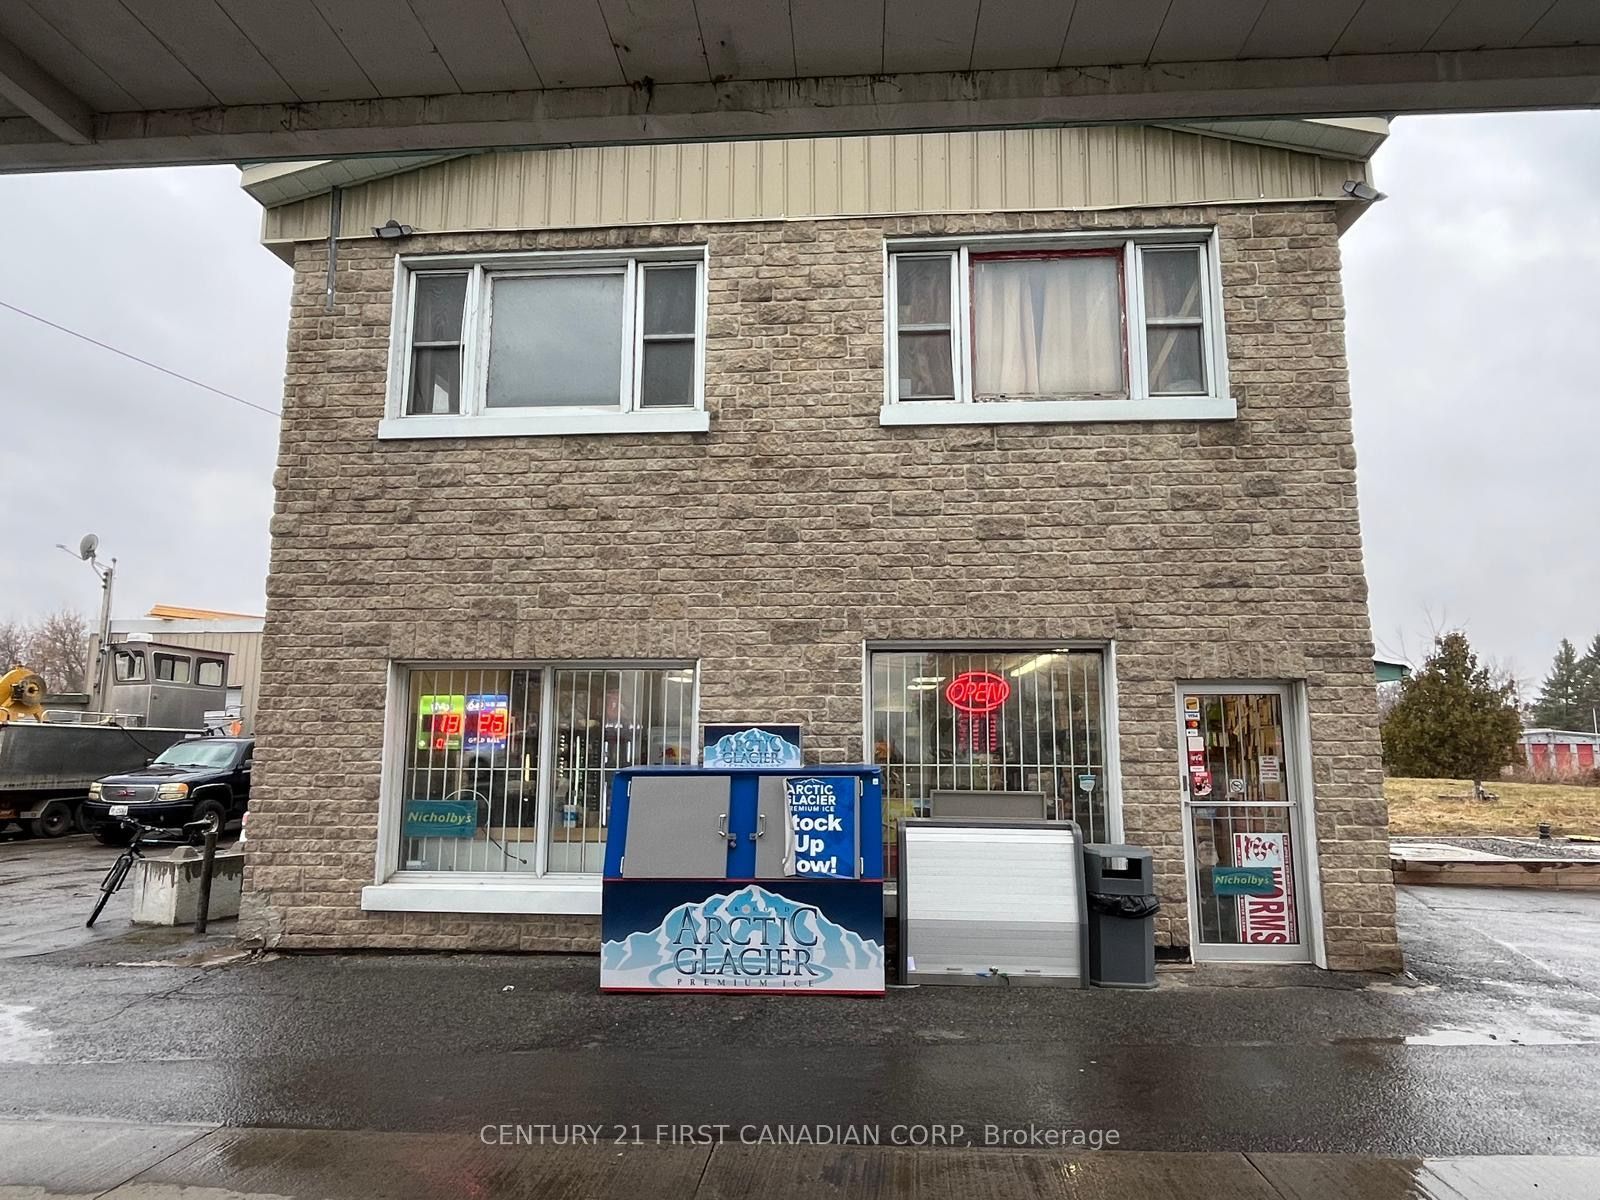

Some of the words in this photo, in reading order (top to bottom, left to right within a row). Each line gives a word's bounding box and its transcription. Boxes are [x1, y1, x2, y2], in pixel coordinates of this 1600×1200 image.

[950, 682, 1003, 701] OPEN
[723, 736, 781, 752] ARCTIC
[722, 752, 781, 764] GLACIER
[792, 814, 843, 831] tock
[795, 834, 825, 857] Up
[796, 856, 837, 874] ow!
[1248, 867, 1288, 944] ORMS
[672, 907, 818, 947] ARCTIC
[673, 947, 819, 976] GLACIER
[677, 978, 768, 987] PREMIUM
[782, 979, 815, 987] ICE
